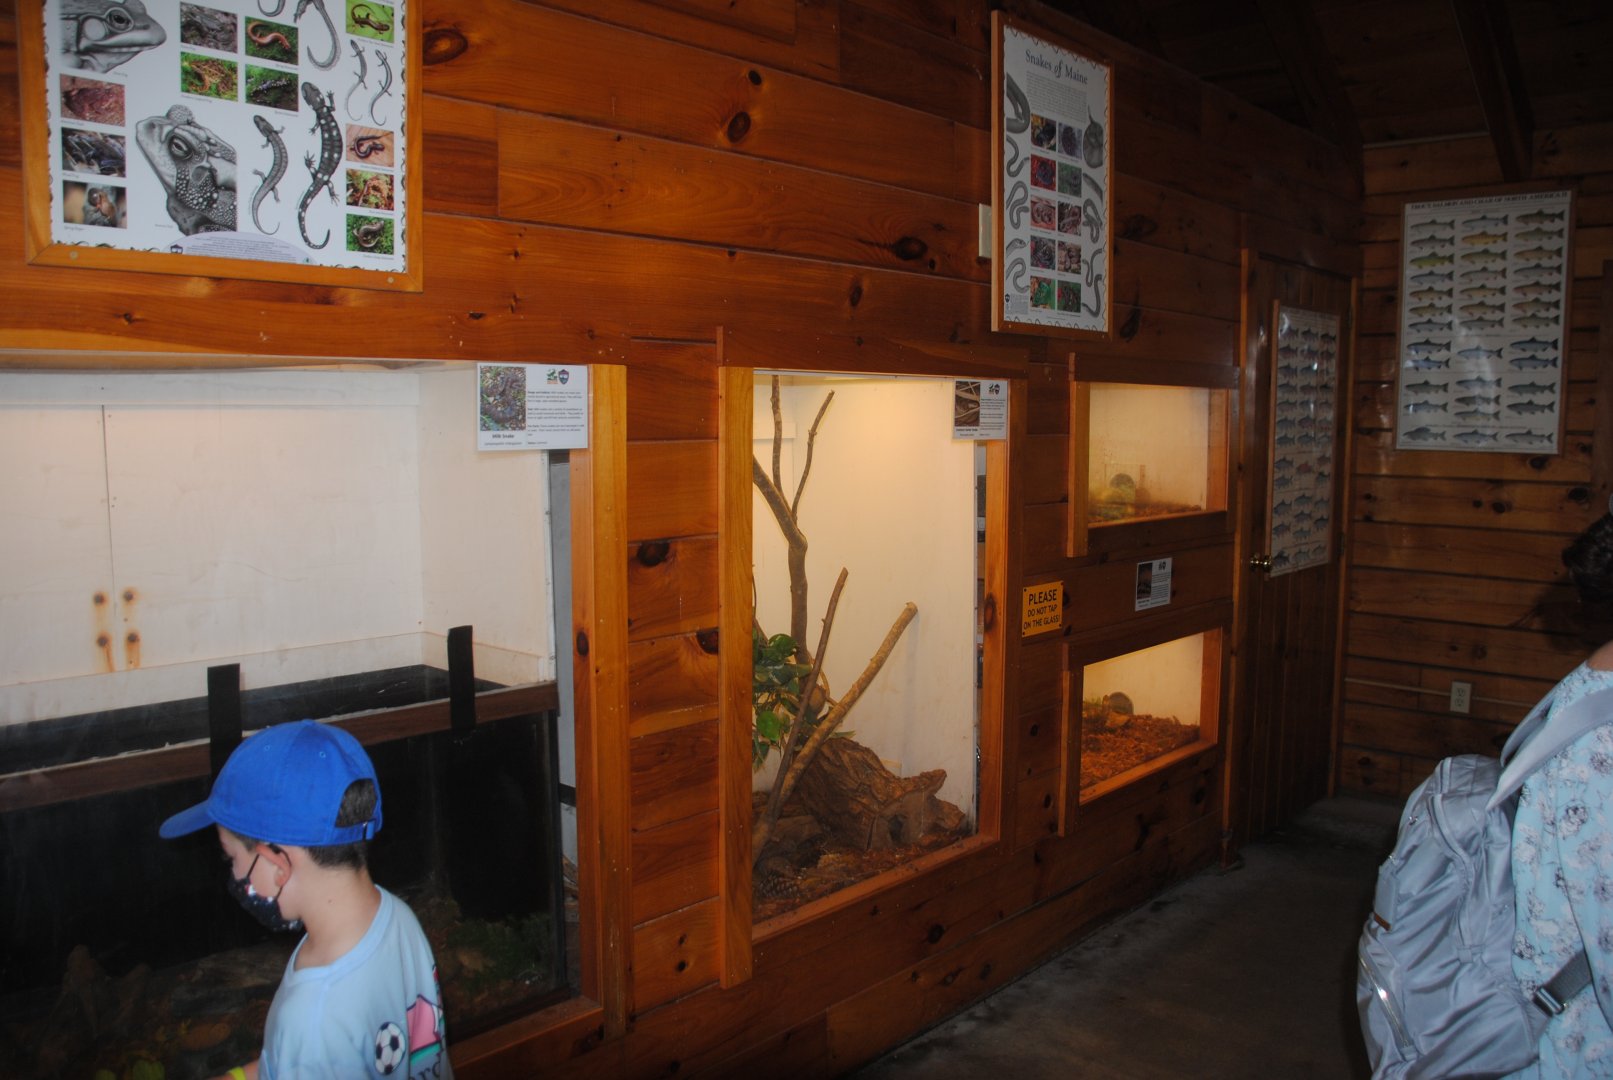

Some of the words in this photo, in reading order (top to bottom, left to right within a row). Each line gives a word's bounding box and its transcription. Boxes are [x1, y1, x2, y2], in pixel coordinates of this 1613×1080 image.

[1025, 48, 1052, 71] Snakes
[1054, 60, 1063, 79] of
[1065, 64, 1088, 85] Maine
[1029, 589, 1057, 606] PLEASE
[1028, 609, 1035, 617] DO
[1036, 606, 1047, 615] NOT
[1024, 621, 1031, 629] ON
[1032, 618, 1042, 627] THE
